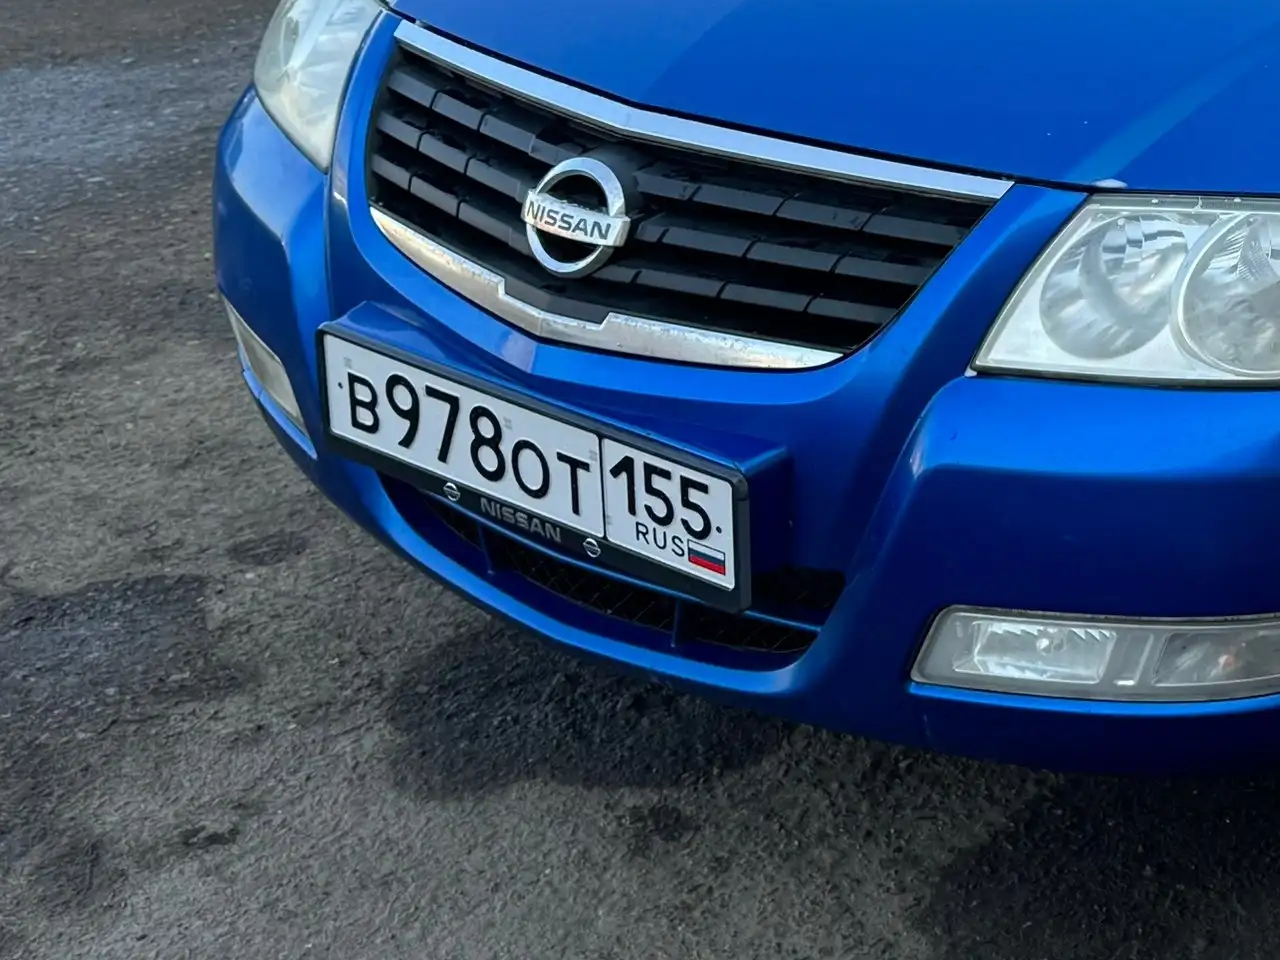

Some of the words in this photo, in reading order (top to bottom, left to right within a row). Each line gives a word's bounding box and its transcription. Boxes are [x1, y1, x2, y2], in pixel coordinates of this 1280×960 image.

[526, 200, 612, 241] NISSAN
[480, 496, 562, 543] NISSAN
[609, 455, 712, 540] 155
[635, 521, 686, 557] RUS
